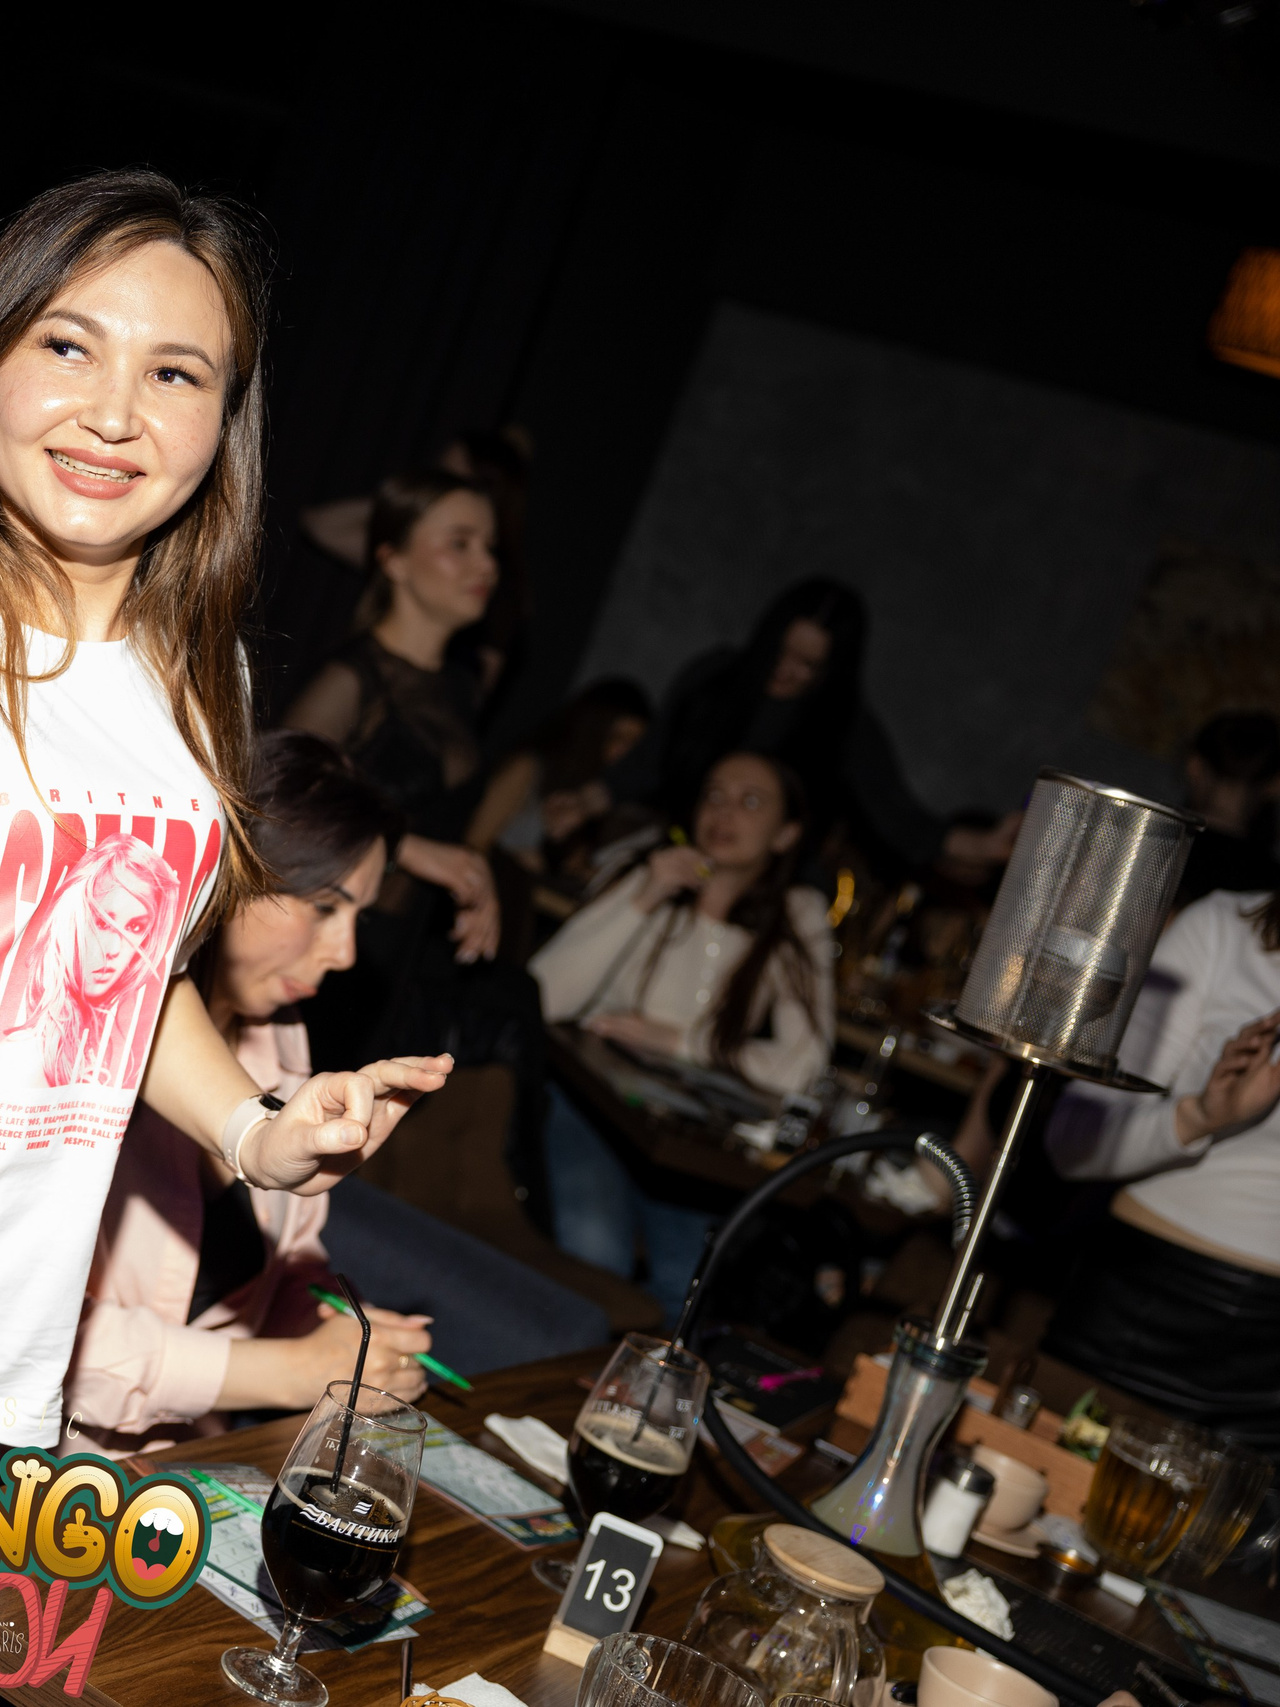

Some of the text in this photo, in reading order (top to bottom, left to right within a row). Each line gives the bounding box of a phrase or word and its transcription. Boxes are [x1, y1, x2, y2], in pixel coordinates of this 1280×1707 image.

[6, 1104, 23, 1113] POP
[25, 1104, 51, 1114] CULTURE
[81, 1101, 96, 1109] AND
[99, 1104, 125, 1115] FIERCE
[5, 1117, 25, 1126] LATE
[43, 1114, 69, 1125] WRAPPED
[78, 1113, 100, 1123] NEON
[24, 1129, 42, 1139] FEELS
[42, 1127, 57, 1137] LIKE
[62, 1124, 88, 1134] MIRROR
[91, 1128, 111, 1139] BALL
[63, 1136, 96, 1149] DESPITE
[315, 1510, 401, 1544] БАЛТИКА
[583, 1558, 636, 1613] 13
